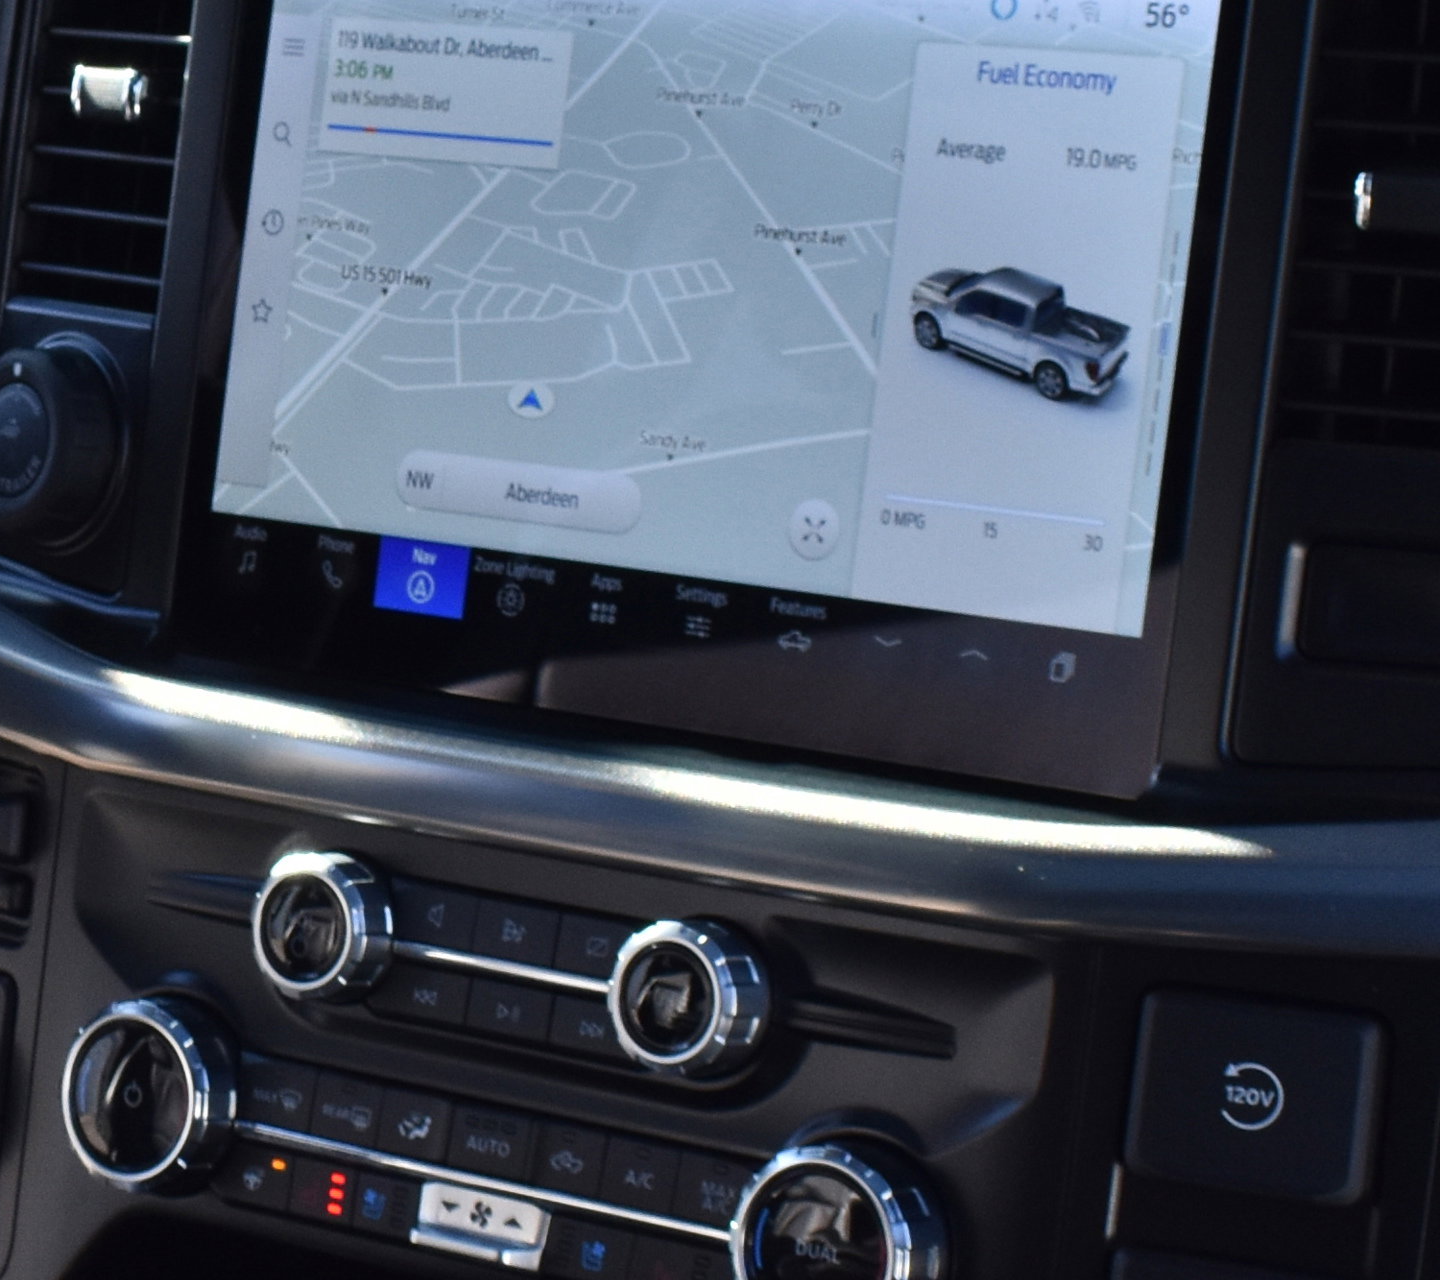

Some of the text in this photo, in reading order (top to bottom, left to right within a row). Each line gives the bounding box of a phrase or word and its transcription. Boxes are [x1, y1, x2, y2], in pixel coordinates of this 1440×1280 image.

[338, 29, 360, 49] 119
[362, 31, 440, 54] Walkabout
[468, 38, 539, 61] Aberdeen
[334, 58, 394, 80] 3:06 PM
[977, 60, 1117, 95] Fuel Economy
[330, 90, 451, 112] via N Sandhills Blvd
[656, 87, 745, 108] Pinehurst Ave
[936, 138, 1006, 165] Average
[1066, 147, 1136, 170] 19.0 MPG
[754, 223, 847, 246] Pinehurst Ave
[341, 265, 360, 281] US
[379, 268, 402, 285] 501
[404, 273, 433, 289] Hwy
[639, 429, 707, 452] Sandy Ave
[406, 469, 434, 490] NW
[505, 482, 579, 509] Aberdeen
[894, 511, 926, 530] MPG
[983, 521, 998, 539] 15
[234, 524, 268, 542] Audio
[317, 533, 355, 555] Phone
[1083, 534, 1103, 552] 30
[411, 547, 437, 567] Nav
[474, 556, 556, 585] Zone Lighting
[590, 572, 622, 592] Apps
[675, 583, 728, 608] Settings
[771, 596, 826, 620] Features
[1225, 1083, 1276, 1109] 120V
[466, 1134, 511, 1158] AUTO
[624, 1169, 656, 1191] A/C
[795, 1238, 841, 1266] DUAL
